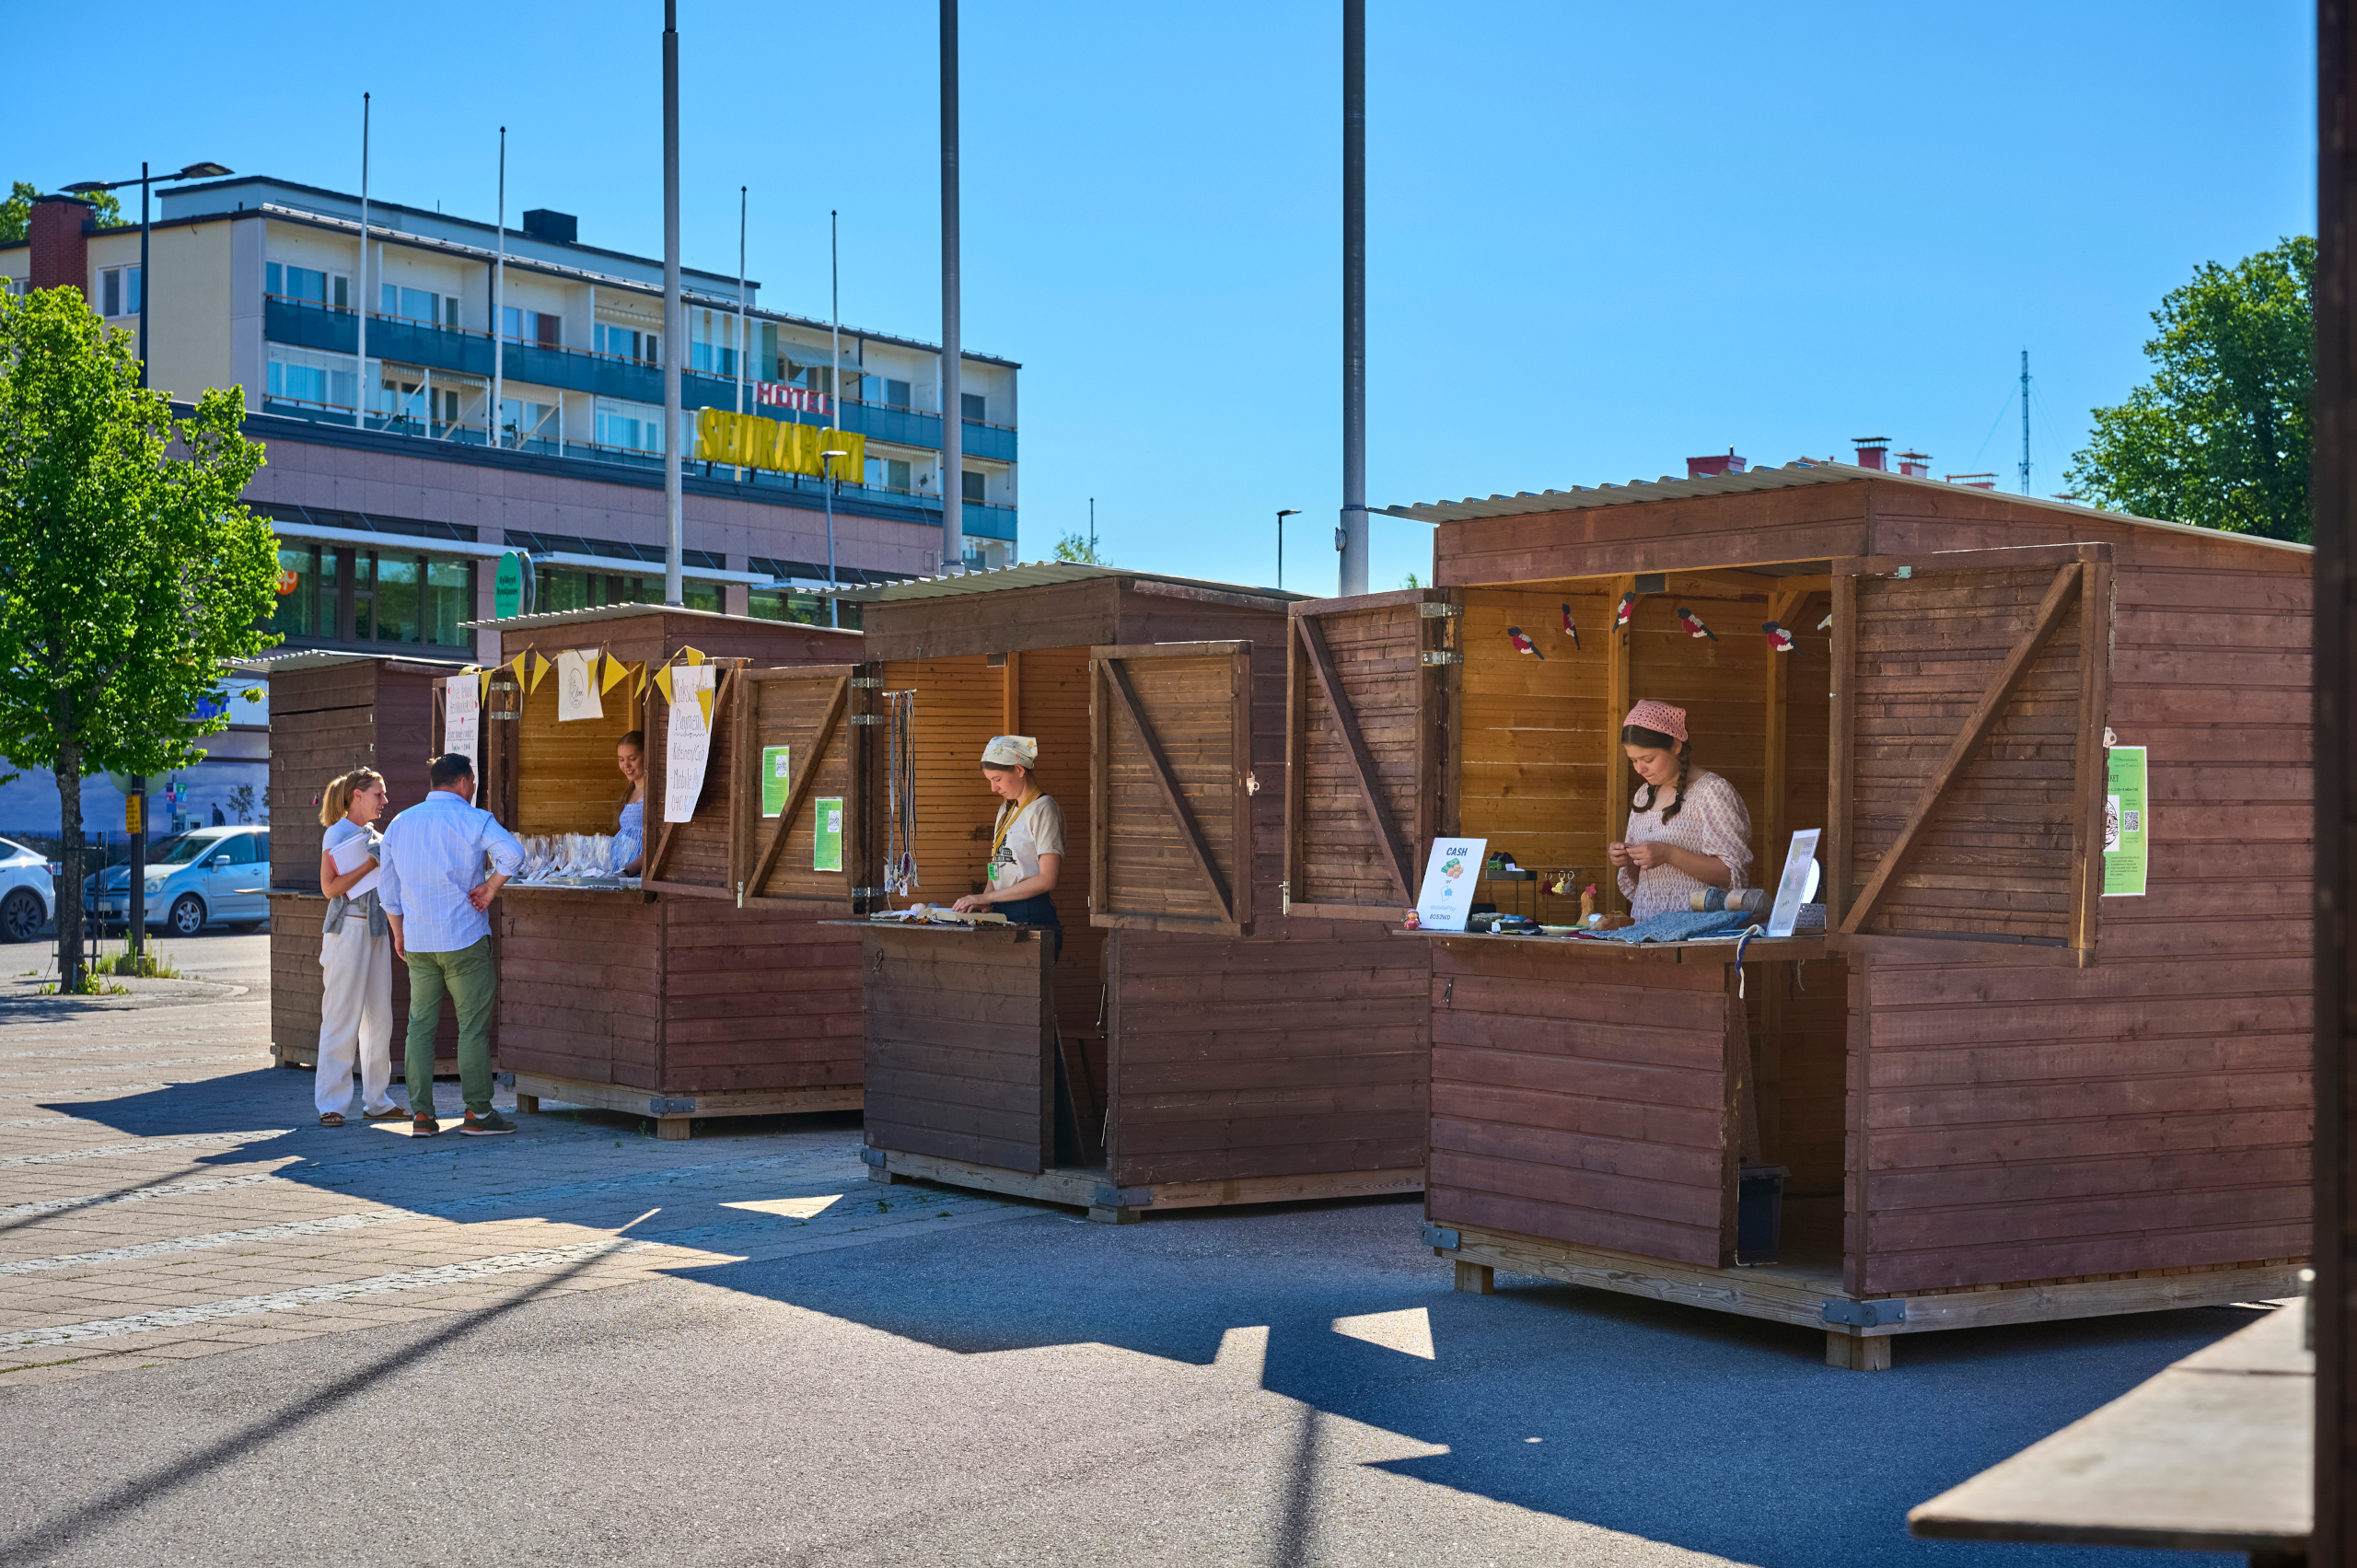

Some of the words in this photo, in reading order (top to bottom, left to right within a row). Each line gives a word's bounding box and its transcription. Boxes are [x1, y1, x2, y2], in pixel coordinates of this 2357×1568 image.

[752, 381, 835, 415] HOTEL
[694, 406, 866, 483] SEURAHOVI
[1446, 847, 1468, 856] CASH
[1430, 904, 1456, 912] MobilePay
